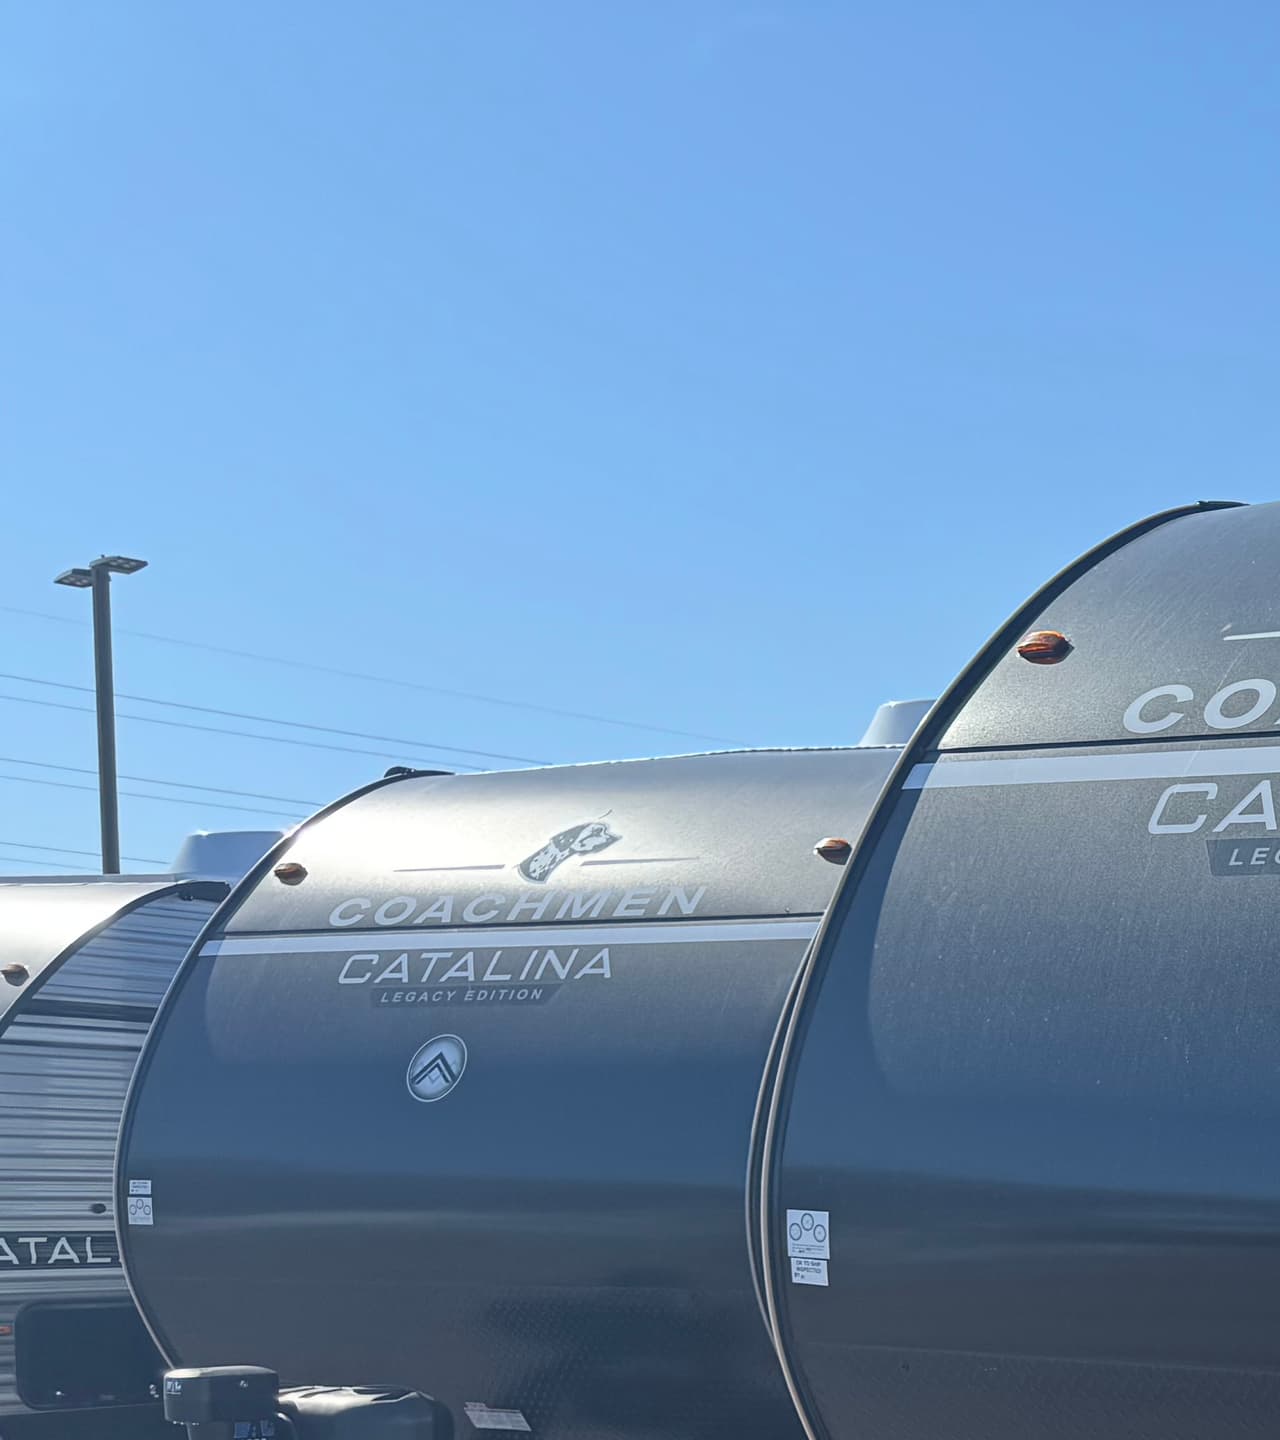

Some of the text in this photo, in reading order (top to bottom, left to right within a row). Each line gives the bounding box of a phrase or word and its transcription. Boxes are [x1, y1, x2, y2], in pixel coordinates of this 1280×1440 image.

[329, 887, 706, 928] COACHMEN
[338, 948, 612, 984] CATALINA
[381, 988, 544, 1003] LEGACY EDITION
